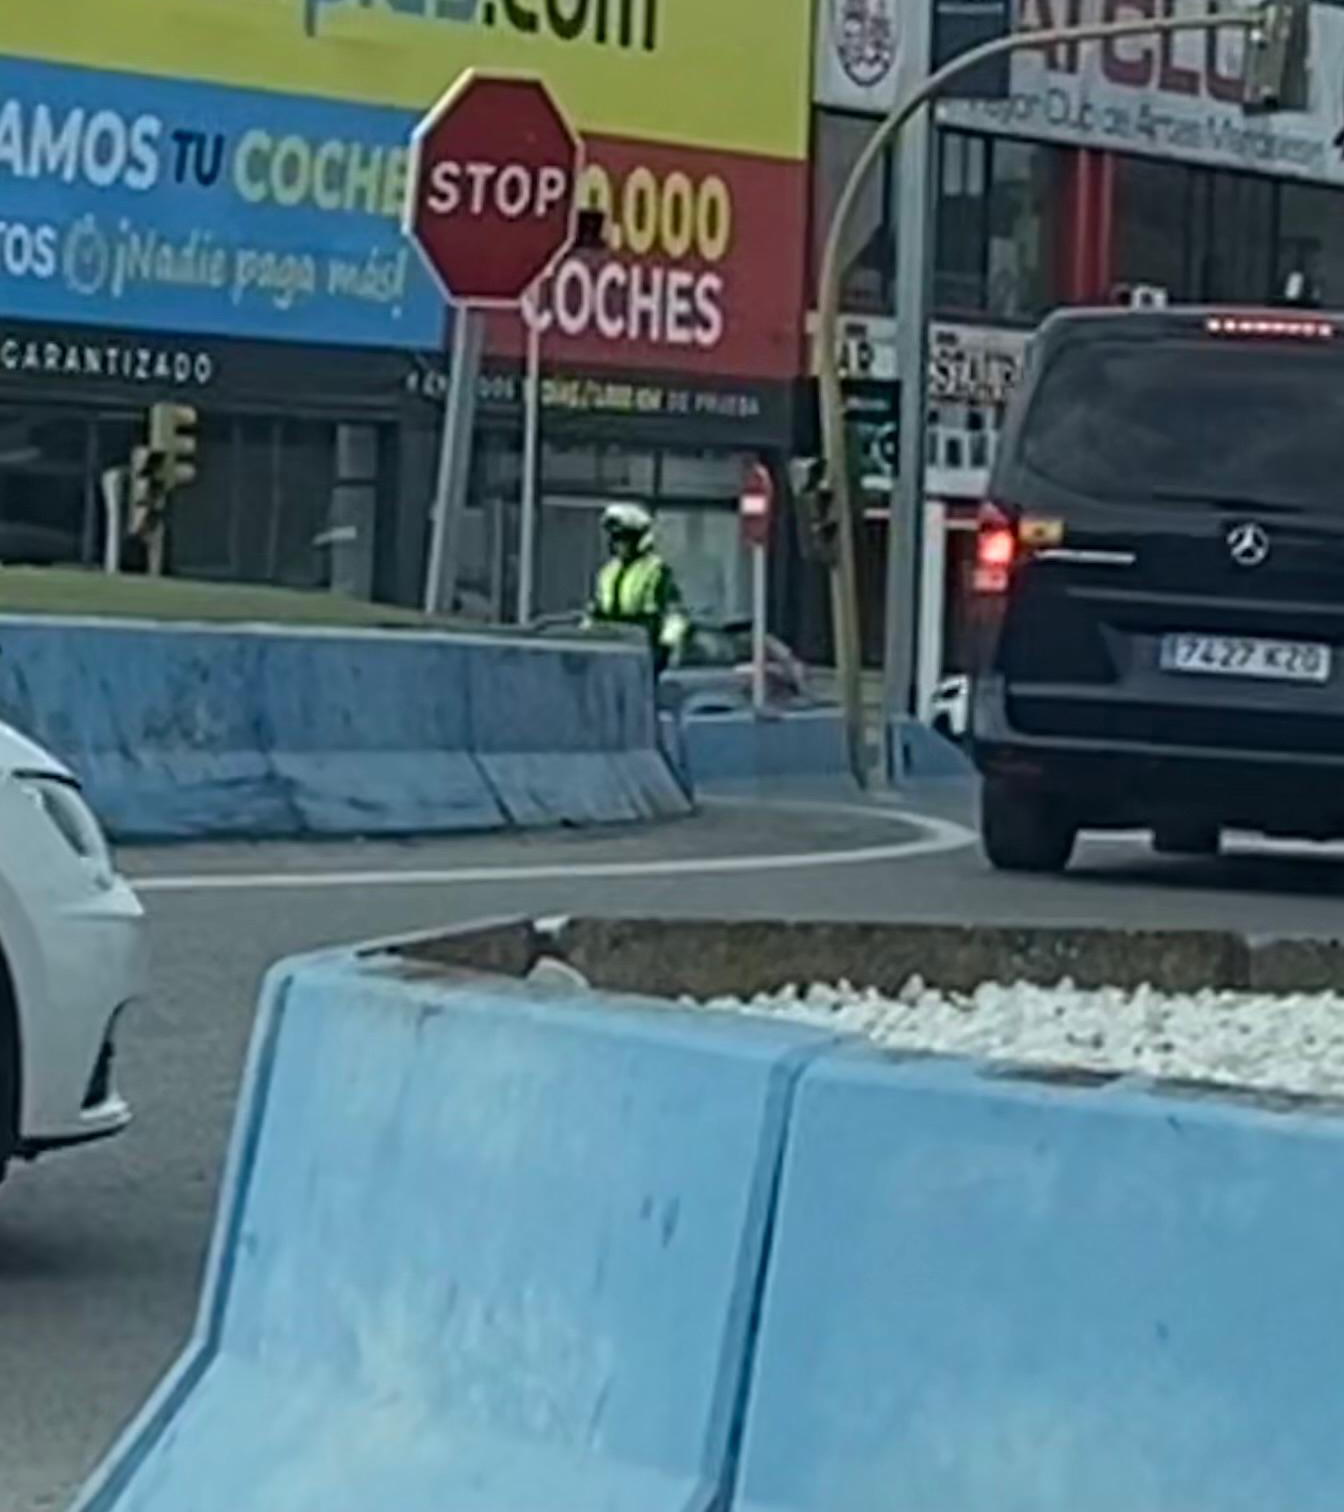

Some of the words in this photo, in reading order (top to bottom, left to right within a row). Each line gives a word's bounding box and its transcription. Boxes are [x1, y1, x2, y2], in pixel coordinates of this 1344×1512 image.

[171, 128, 225, 187] TU
[233, 128, 407, 218] COCHE
[427, 159, 568, 218] STOP
[0, 339, 213, 384] GARANTIZADO
[1178, 637, 1256, 668] 7427
